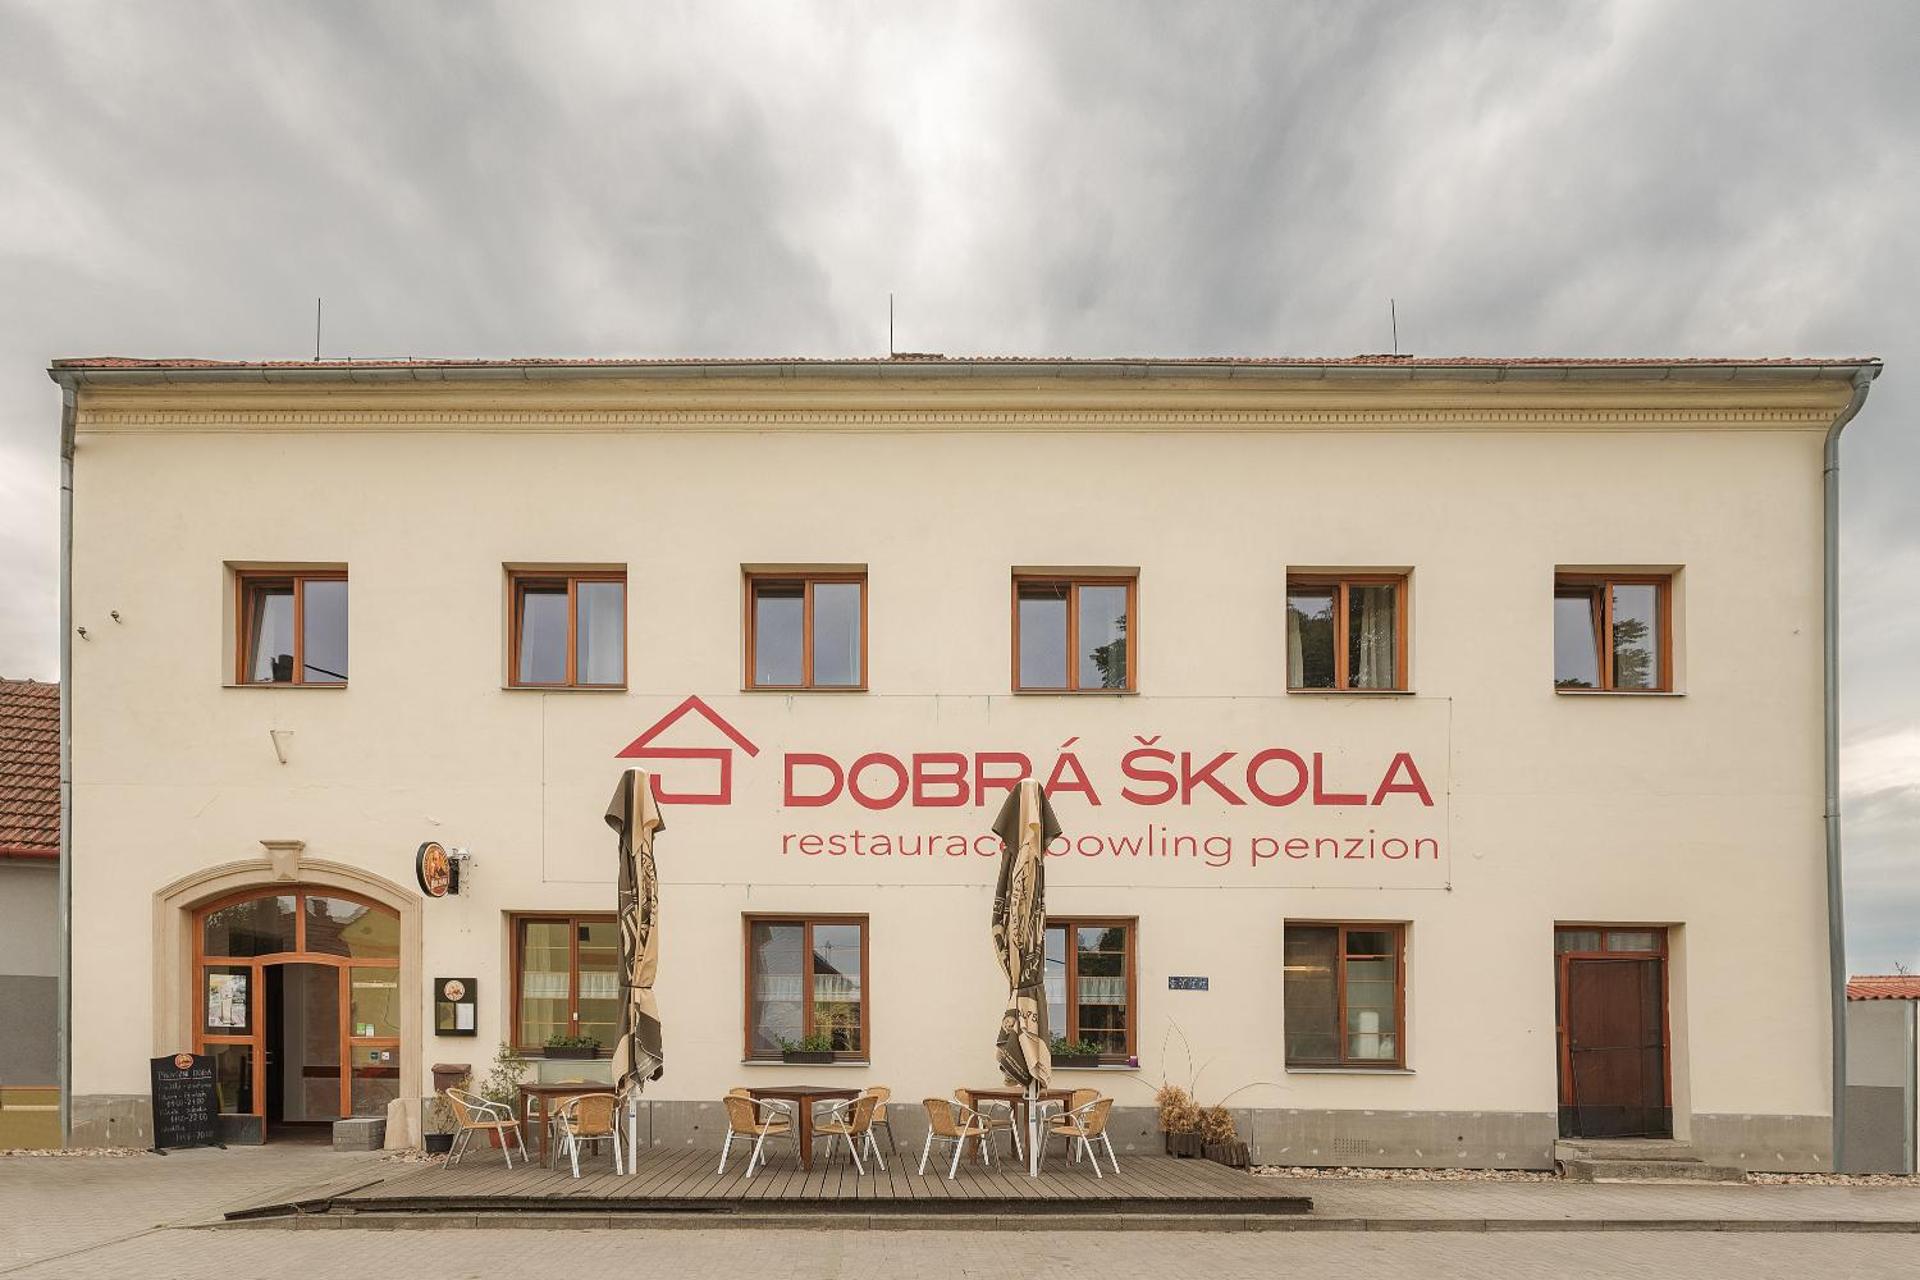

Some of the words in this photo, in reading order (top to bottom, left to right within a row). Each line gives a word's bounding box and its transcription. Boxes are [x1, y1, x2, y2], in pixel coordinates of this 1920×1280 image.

[783, 736, 1102, 811] DOBRÁ
[1120, 735, 1434, 808] ŠKOLA
[1251, 829, 1439, 867] penzion
